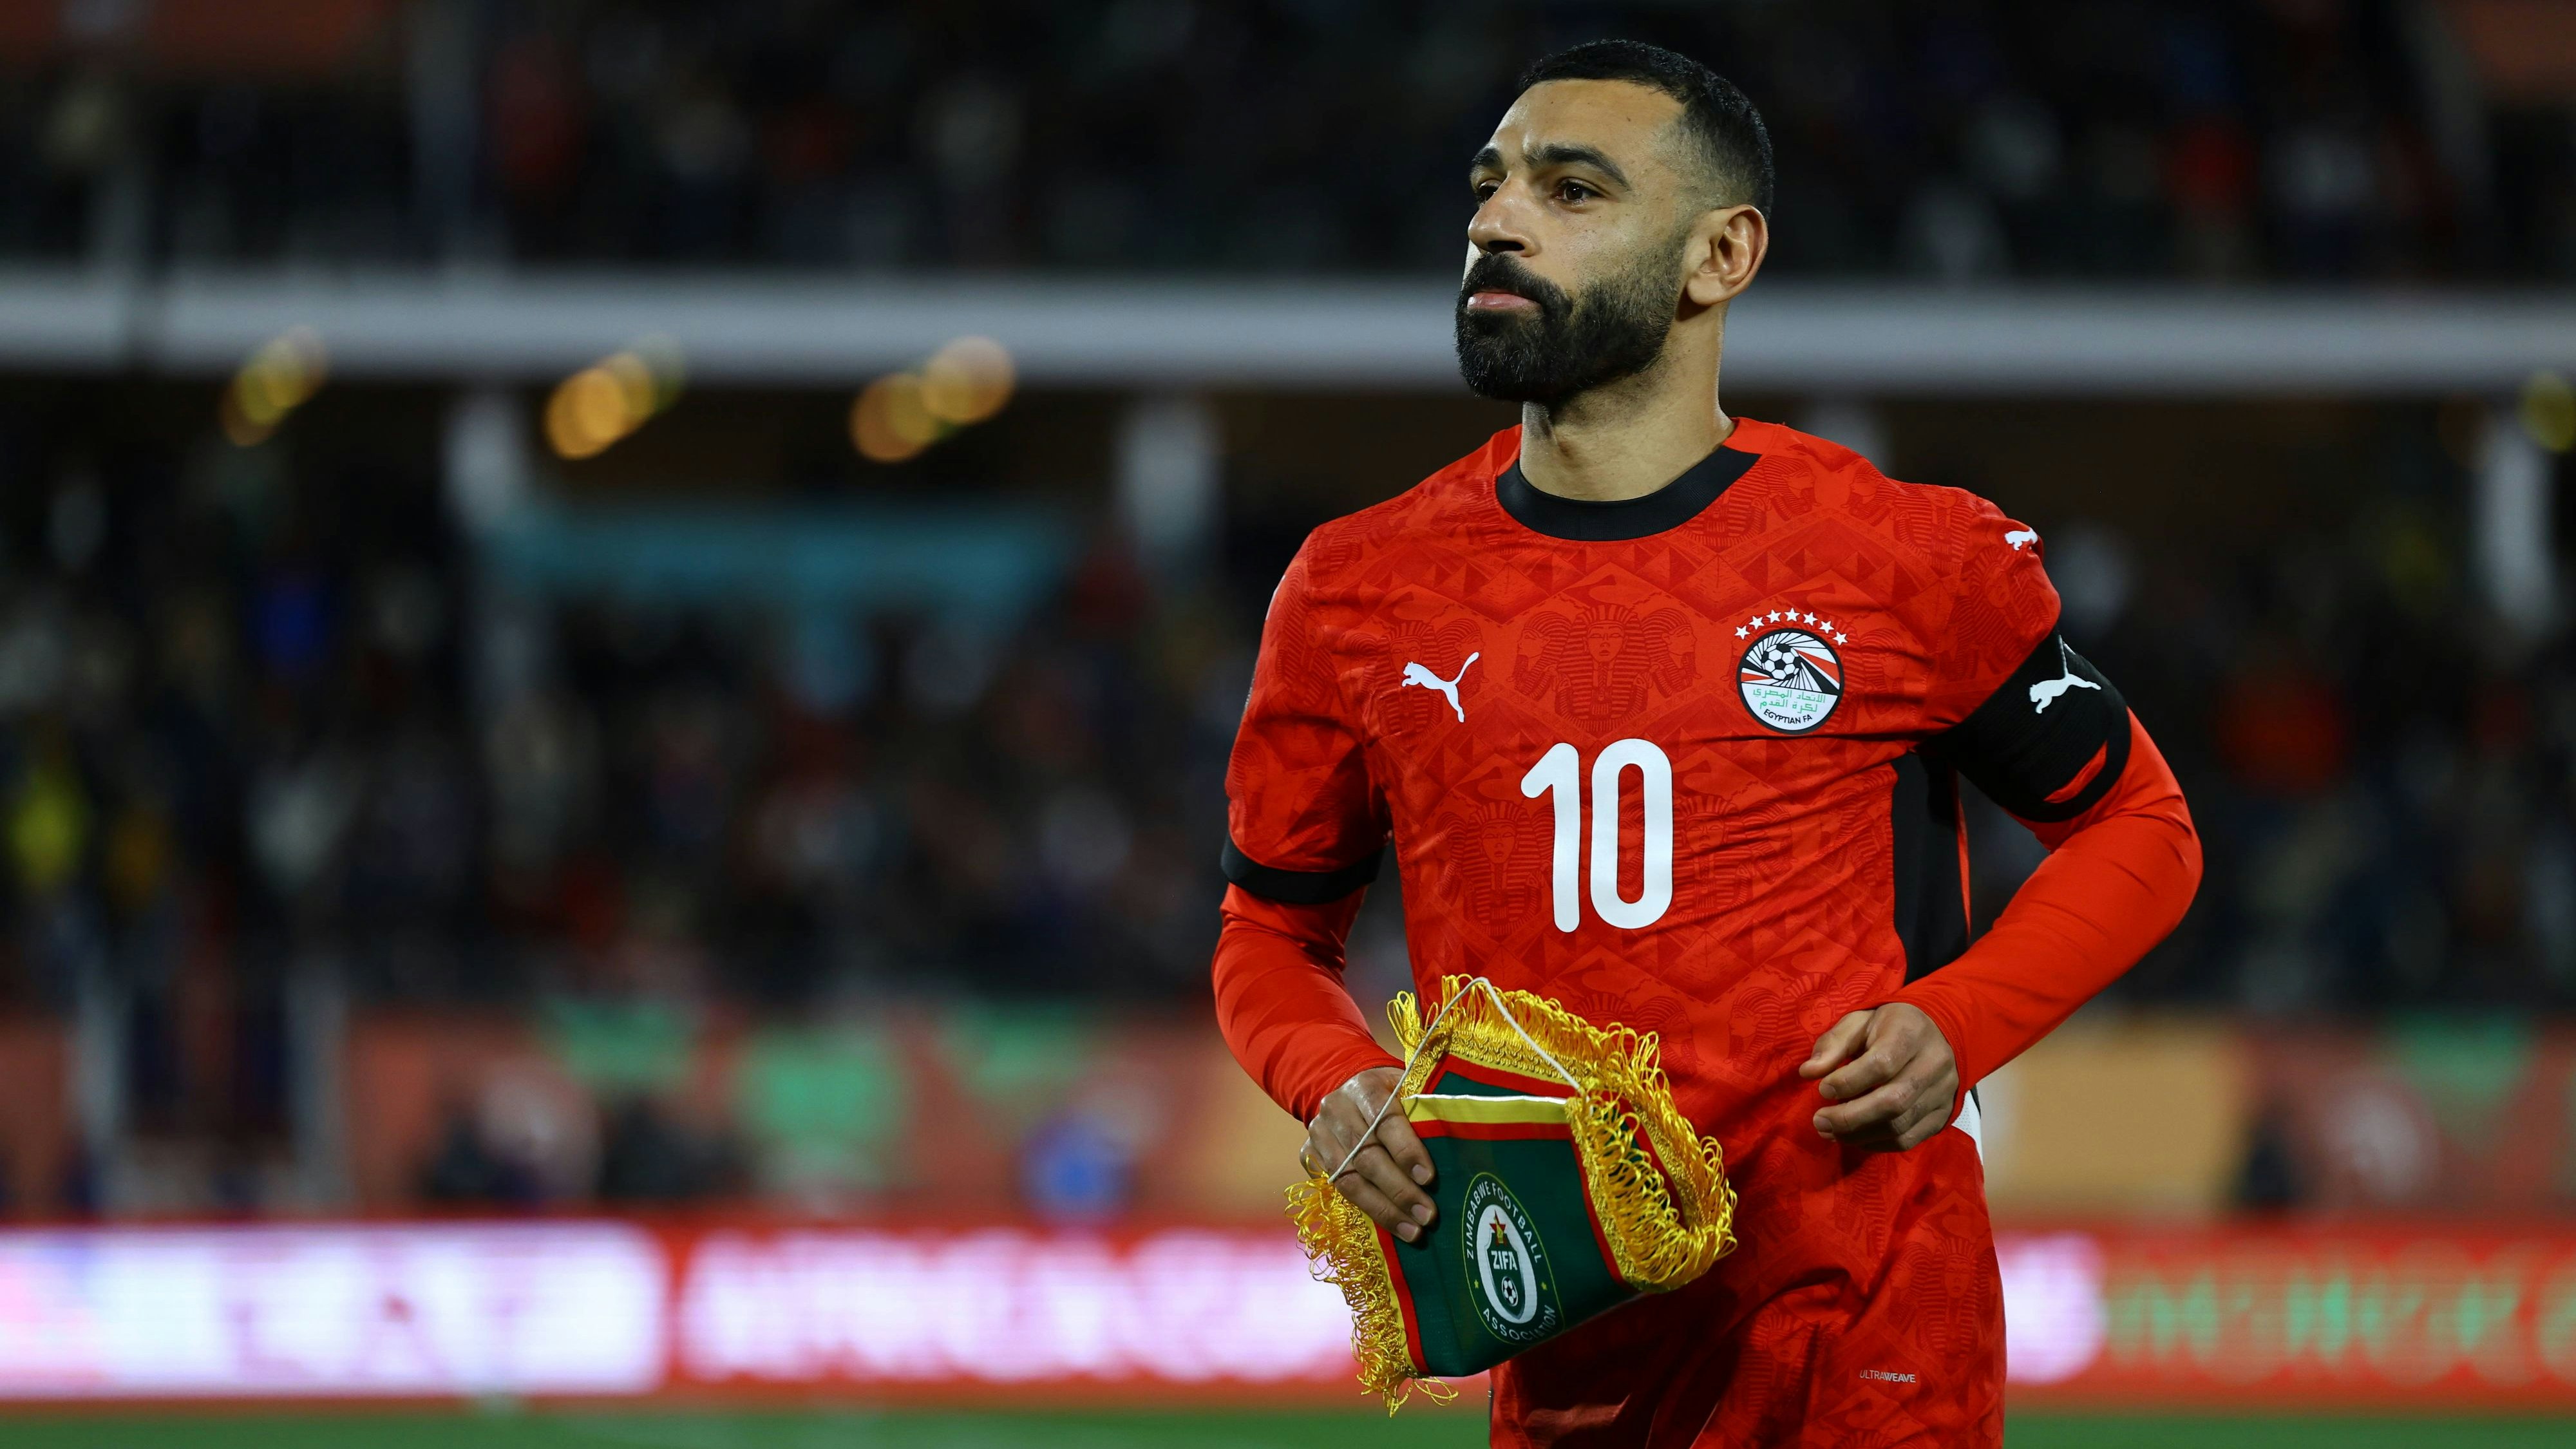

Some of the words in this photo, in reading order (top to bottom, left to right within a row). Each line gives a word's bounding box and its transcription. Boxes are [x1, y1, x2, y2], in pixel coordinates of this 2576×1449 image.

[1752, 688, 1792, 699] المصري
[1797, 691, 1826, 703] الاتحاد
[1759, 699, 1788, 709] القدم
[1763, 708, 1801, 724] EGYPTIAN
[1803, 714, 1812, 722] FA
[1520, 738, 1673, 933] 10
[1466, 1180, 1491, 1260] ZIMBABWE
[1492, 1182, 1542, 1264] FOOTBALL
[1491, 1250, 1518, 1271] ZIFA
[1483, 1305, 1556, 1340] ASSOCIATION
[1859, 1369, 1917, 1383] ULTRAWEAVE
